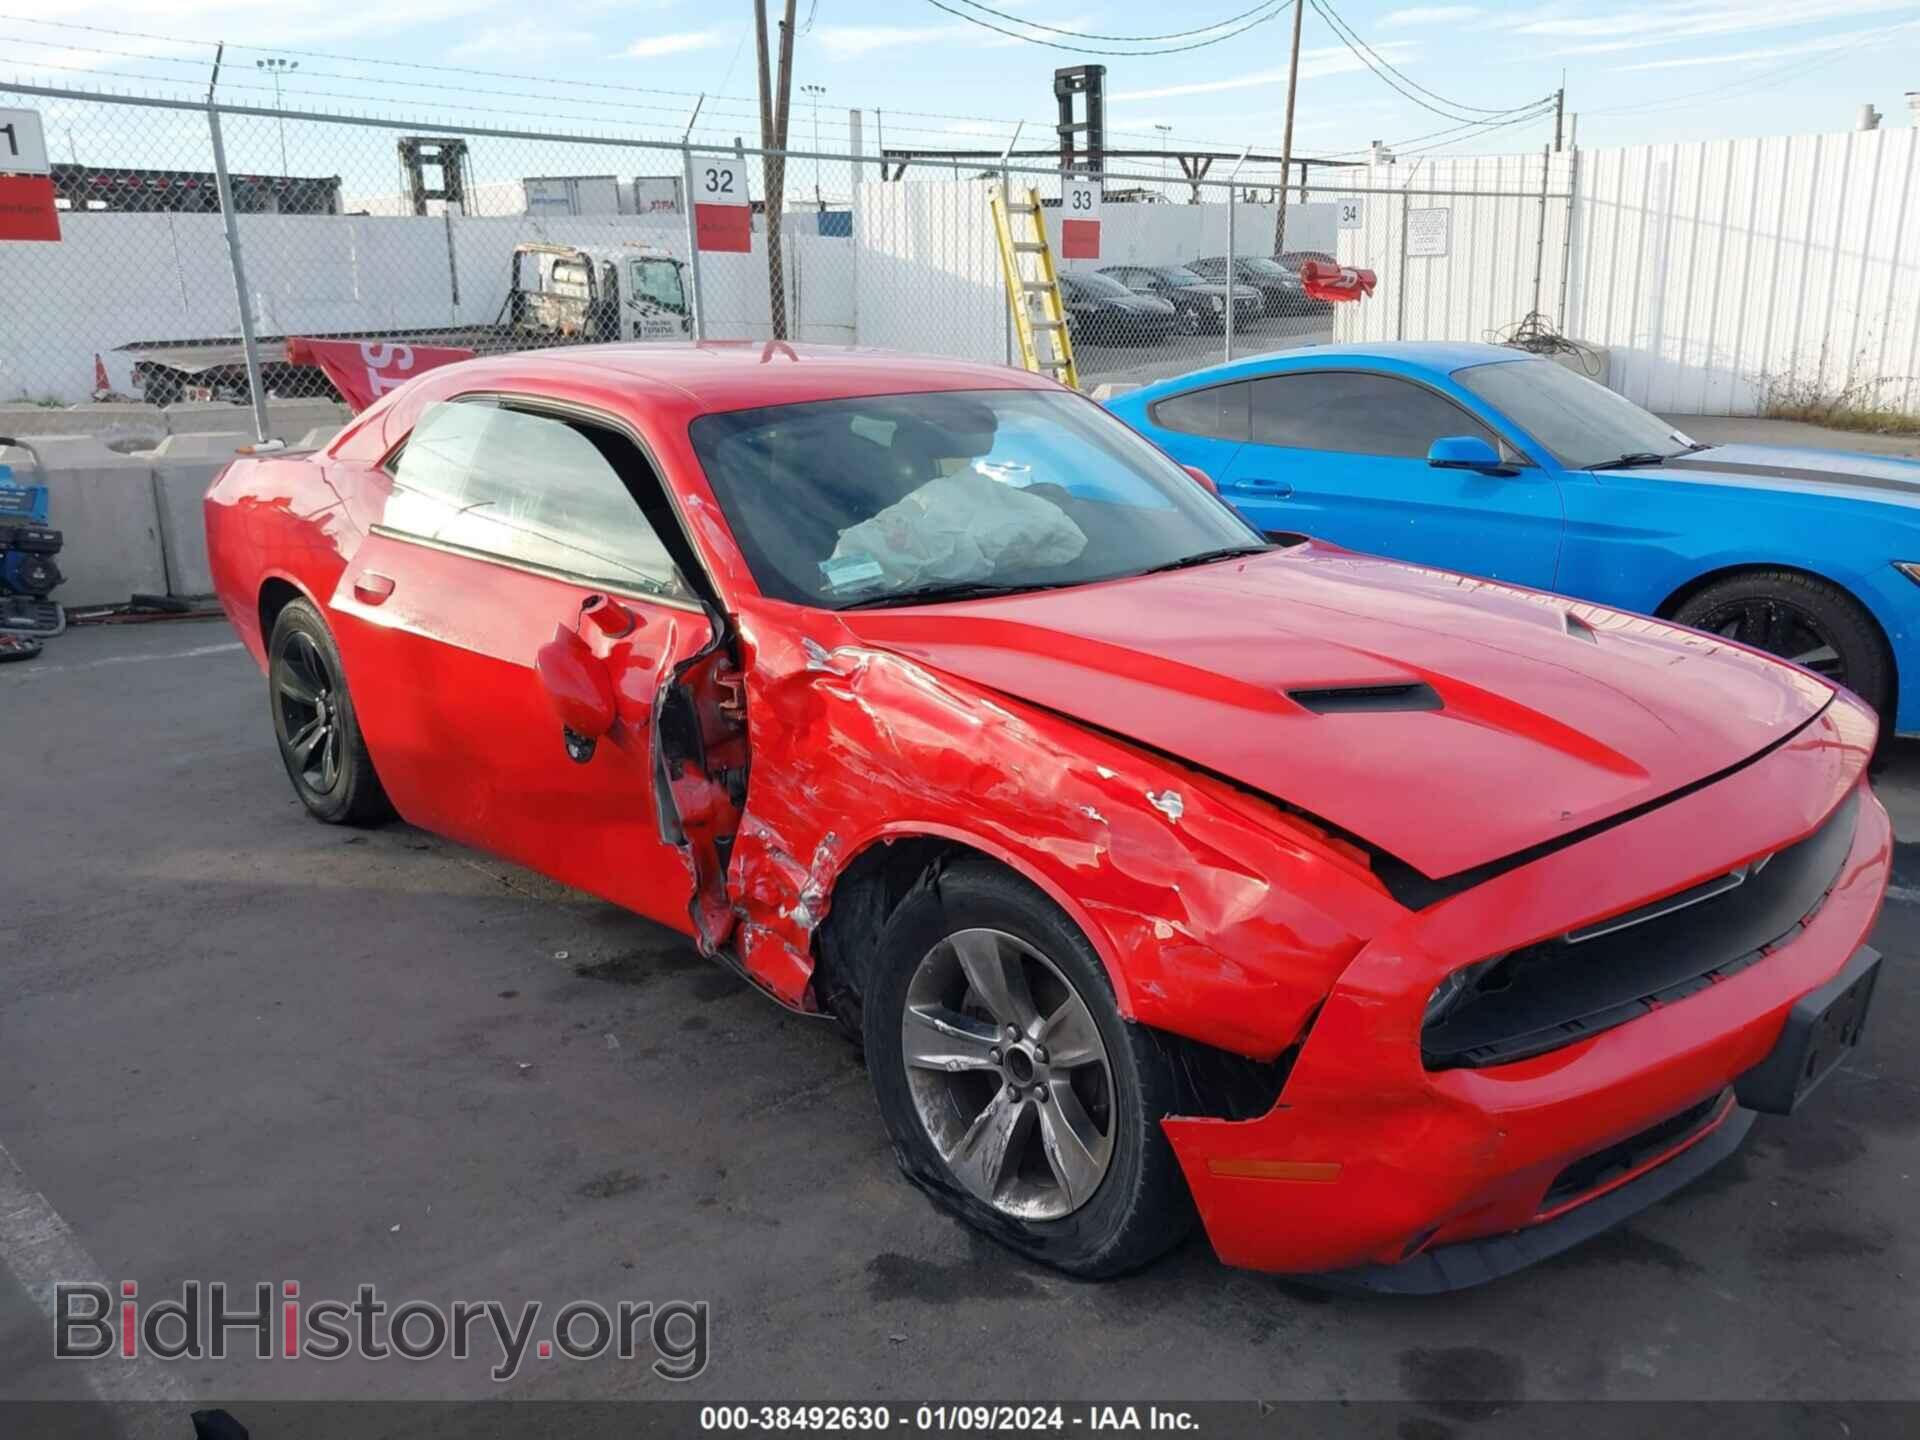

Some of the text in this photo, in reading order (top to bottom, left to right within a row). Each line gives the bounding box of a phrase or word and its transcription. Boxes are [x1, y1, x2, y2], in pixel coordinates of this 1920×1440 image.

[705, 168, 734, 193] 32
[1072, 190, 1092, 210] 33
[1343, 205, 1357, 222] 34
